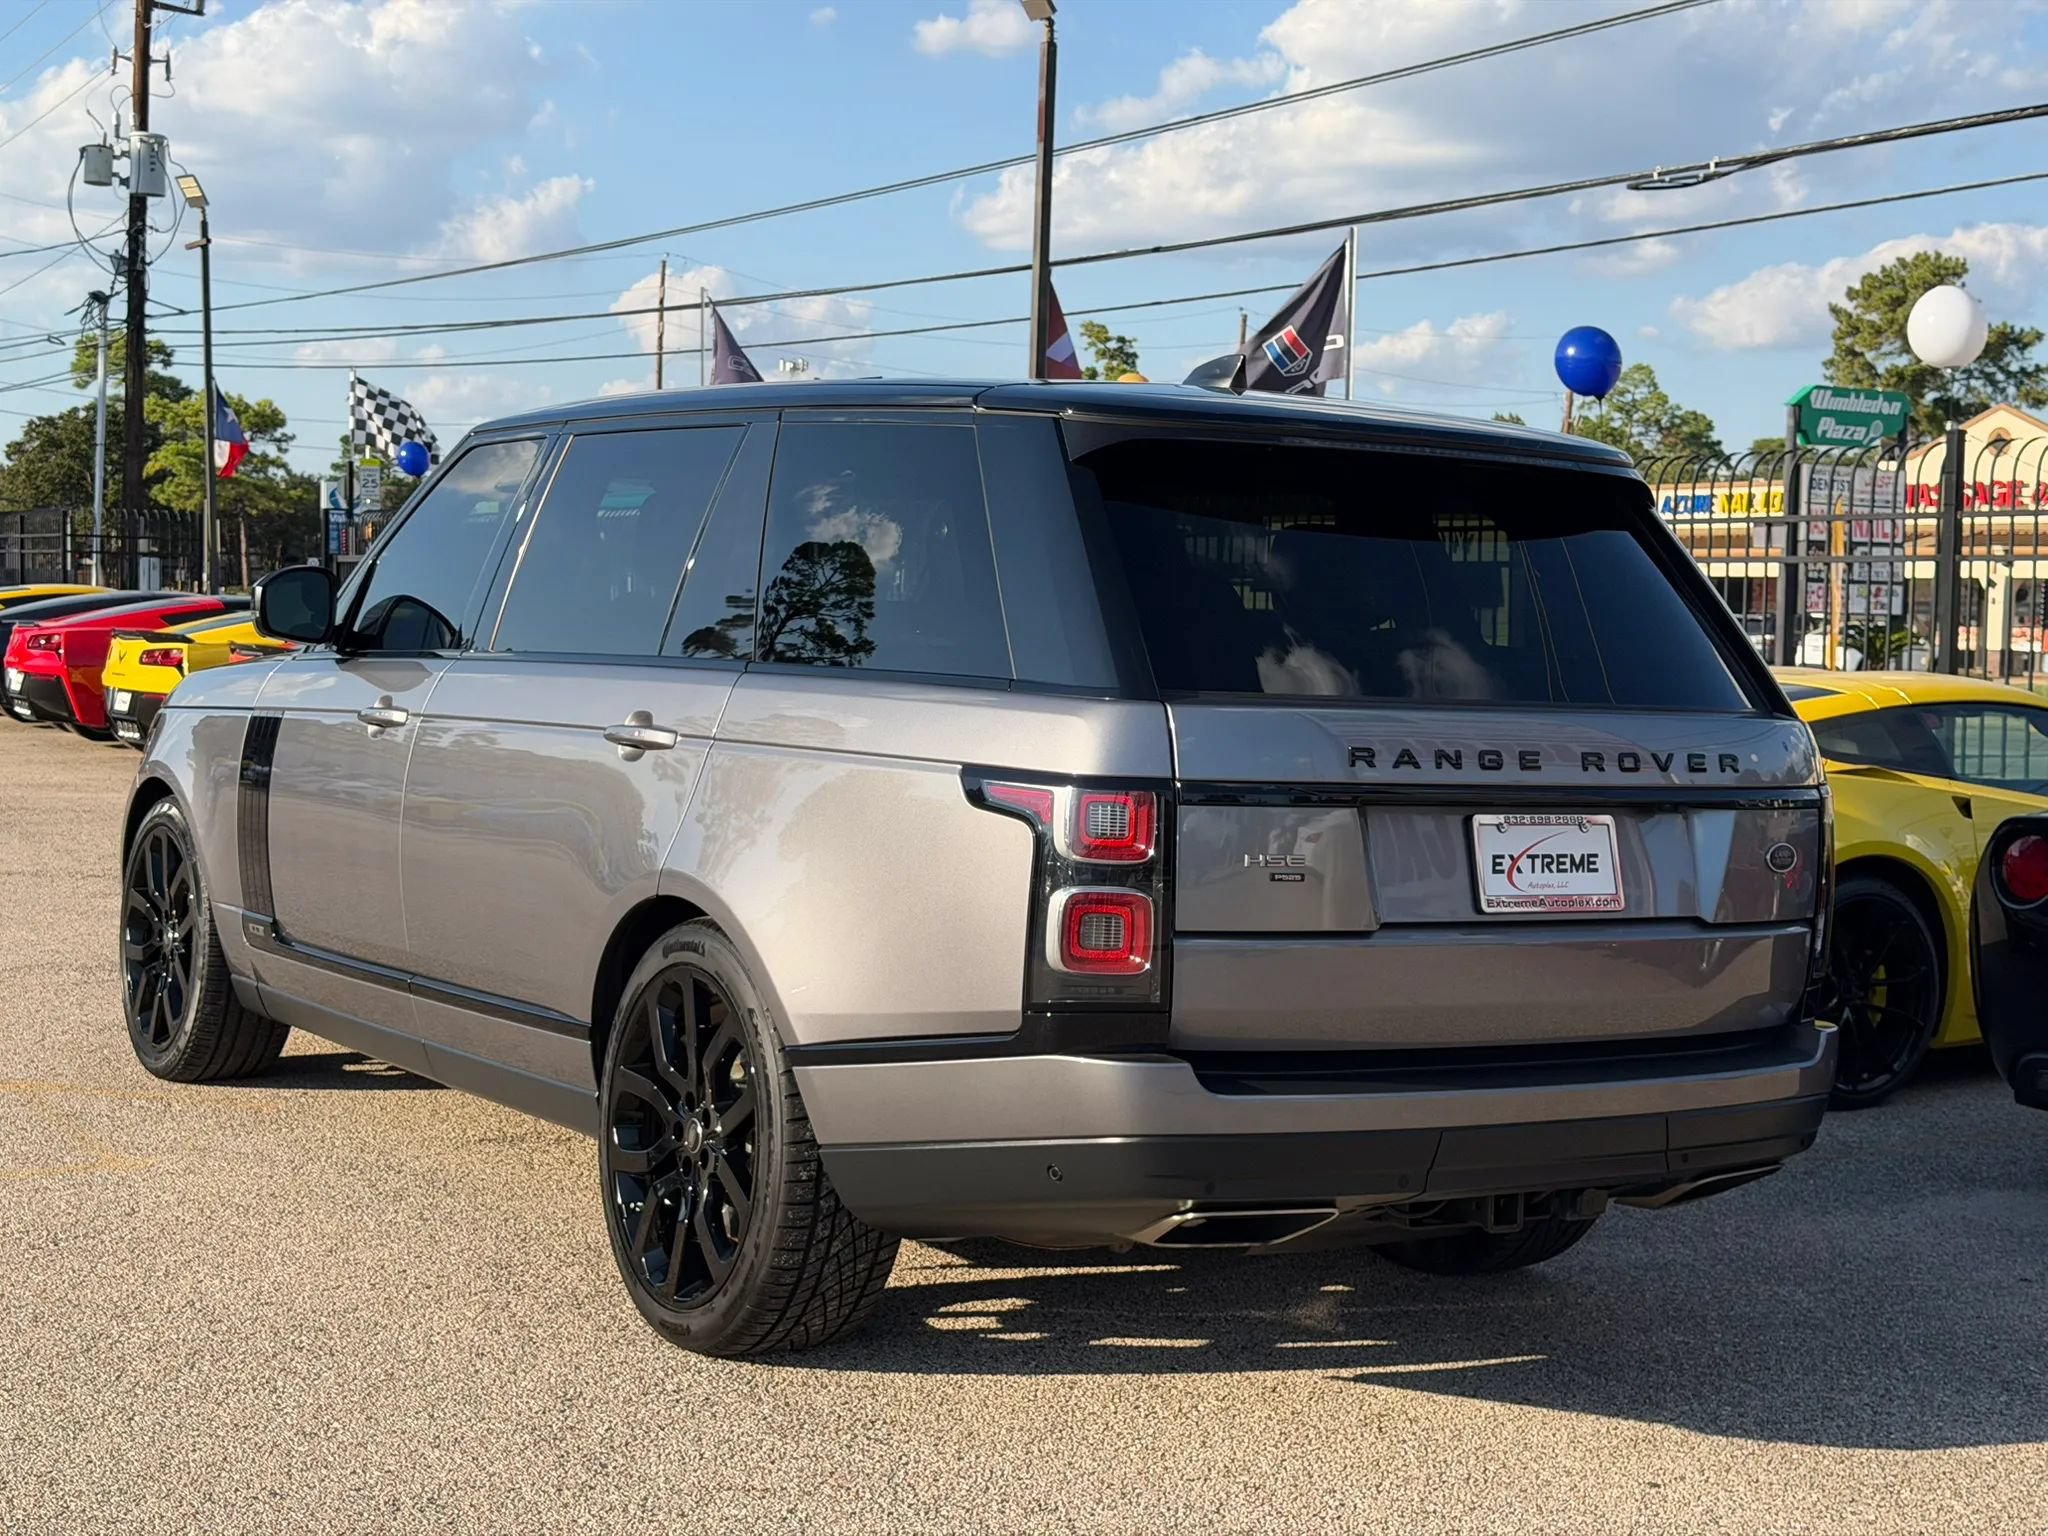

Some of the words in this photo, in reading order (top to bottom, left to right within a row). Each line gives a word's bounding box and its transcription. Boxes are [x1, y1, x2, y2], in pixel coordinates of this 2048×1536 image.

[1810, 389, 1902, 415] Wimbledon
[1817, 416, 1868, 440] Plaza
[362, 478, 378, 489] 25
[1347, 746, 1542, 771] RANGE
[1581, 751, 1740, 774] ROVER
[1244, 853, 1305, 868] HSE
[1491, 853, 1599, 875] EXTREME
[1557, 881, 1569, 889] LLC
